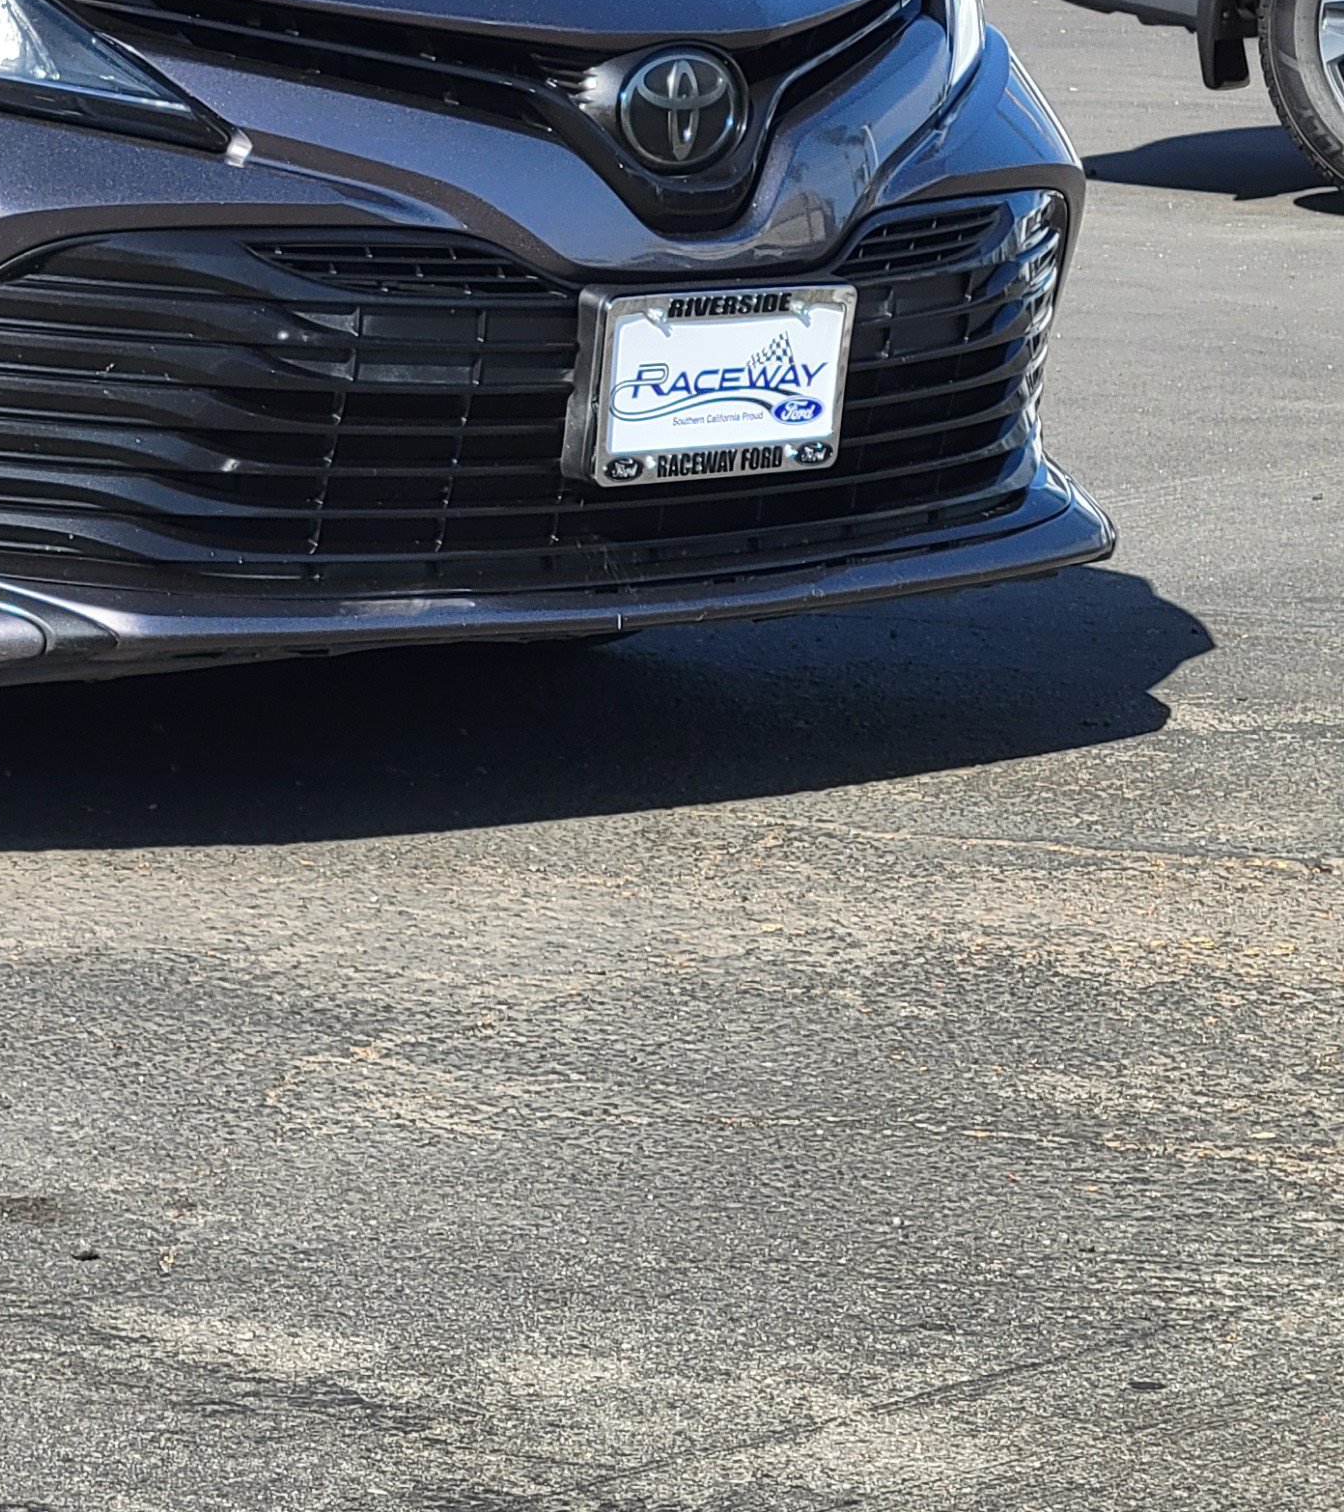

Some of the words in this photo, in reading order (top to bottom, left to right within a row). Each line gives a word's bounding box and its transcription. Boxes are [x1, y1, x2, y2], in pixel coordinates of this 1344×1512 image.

[667, 292, 793, 318] RIVERSIDE
[631, 362, 828, 398] RACEWAY
[672, 416, 704, 427] Southern
[706, 412, 740, 424] California
[742, 411, 763, 421] Proud
[779, 400, 816, 421] Ford
[657, 448, 737, 478] RACEWAY
[740, 446, 784, 471] FORD
